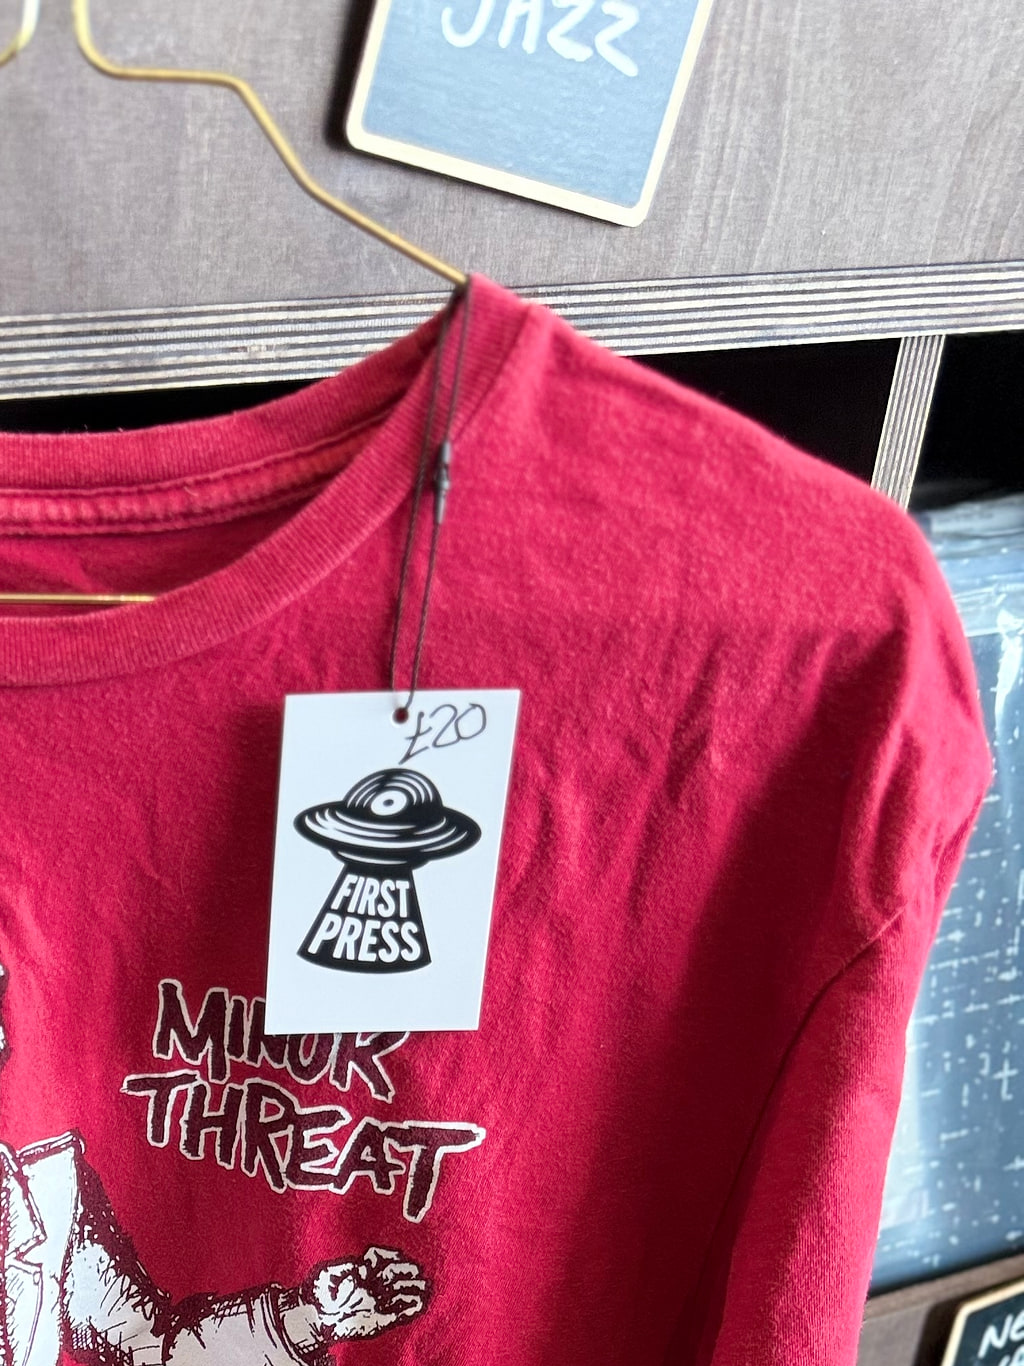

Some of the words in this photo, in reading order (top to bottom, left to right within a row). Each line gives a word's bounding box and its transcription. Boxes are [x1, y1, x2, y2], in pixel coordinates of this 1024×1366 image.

[441, 0, 639, 77] JAZZ
[398, 702, 488, 766] £20
[330, 873, 411, 919] FIRST
[306, 912, 422, 964] PRESS
[120, 1070, 487, 1223] THREAT
